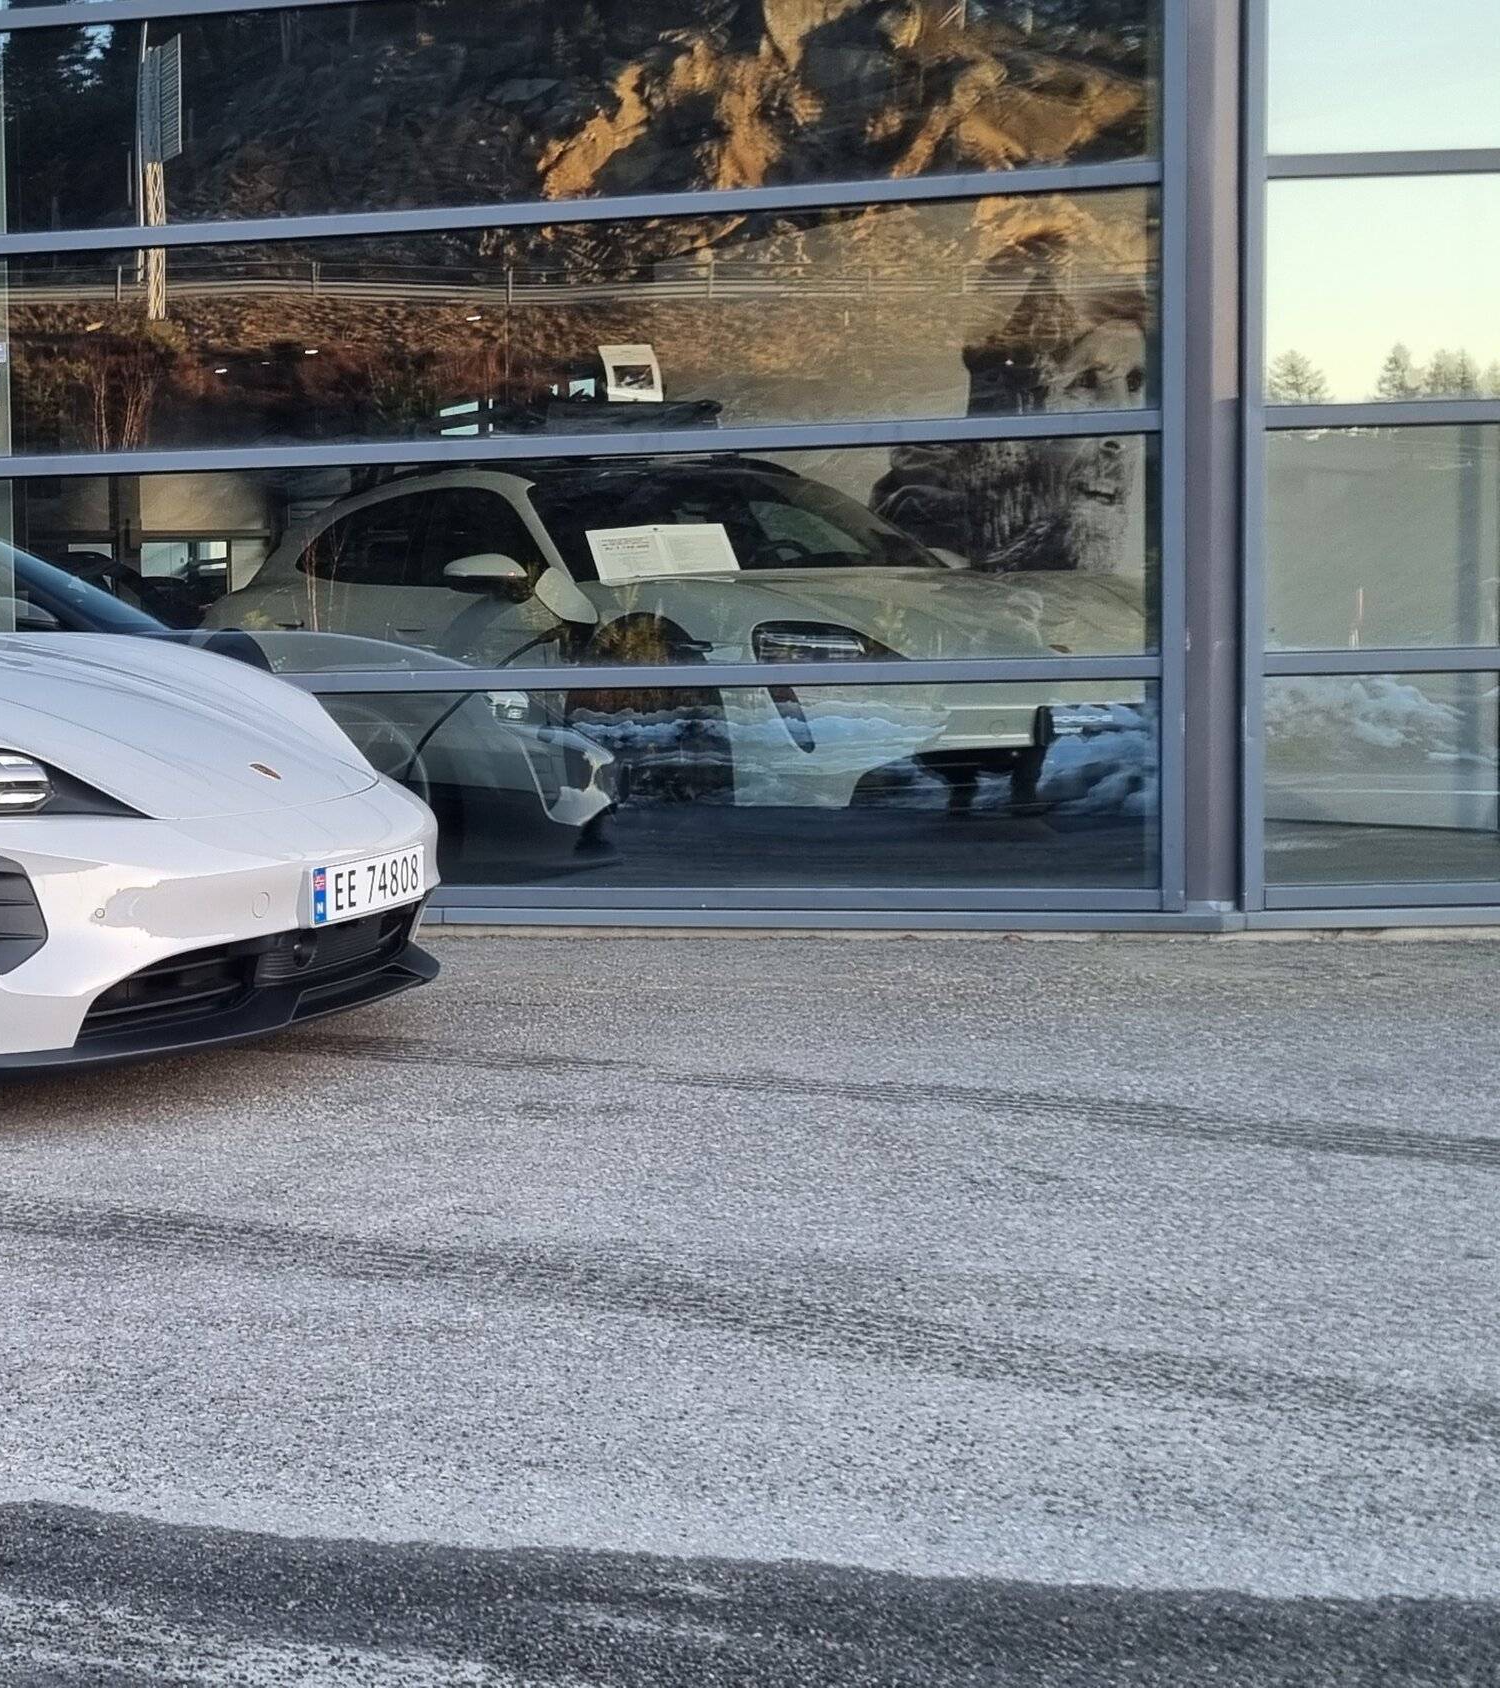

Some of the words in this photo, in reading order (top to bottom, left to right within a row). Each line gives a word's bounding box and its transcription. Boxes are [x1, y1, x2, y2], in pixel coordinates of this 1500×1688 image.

[334, 869, 357, 911] EE
[366, 853, 419, 904] 74808
[316, 902, 324, 912] N
